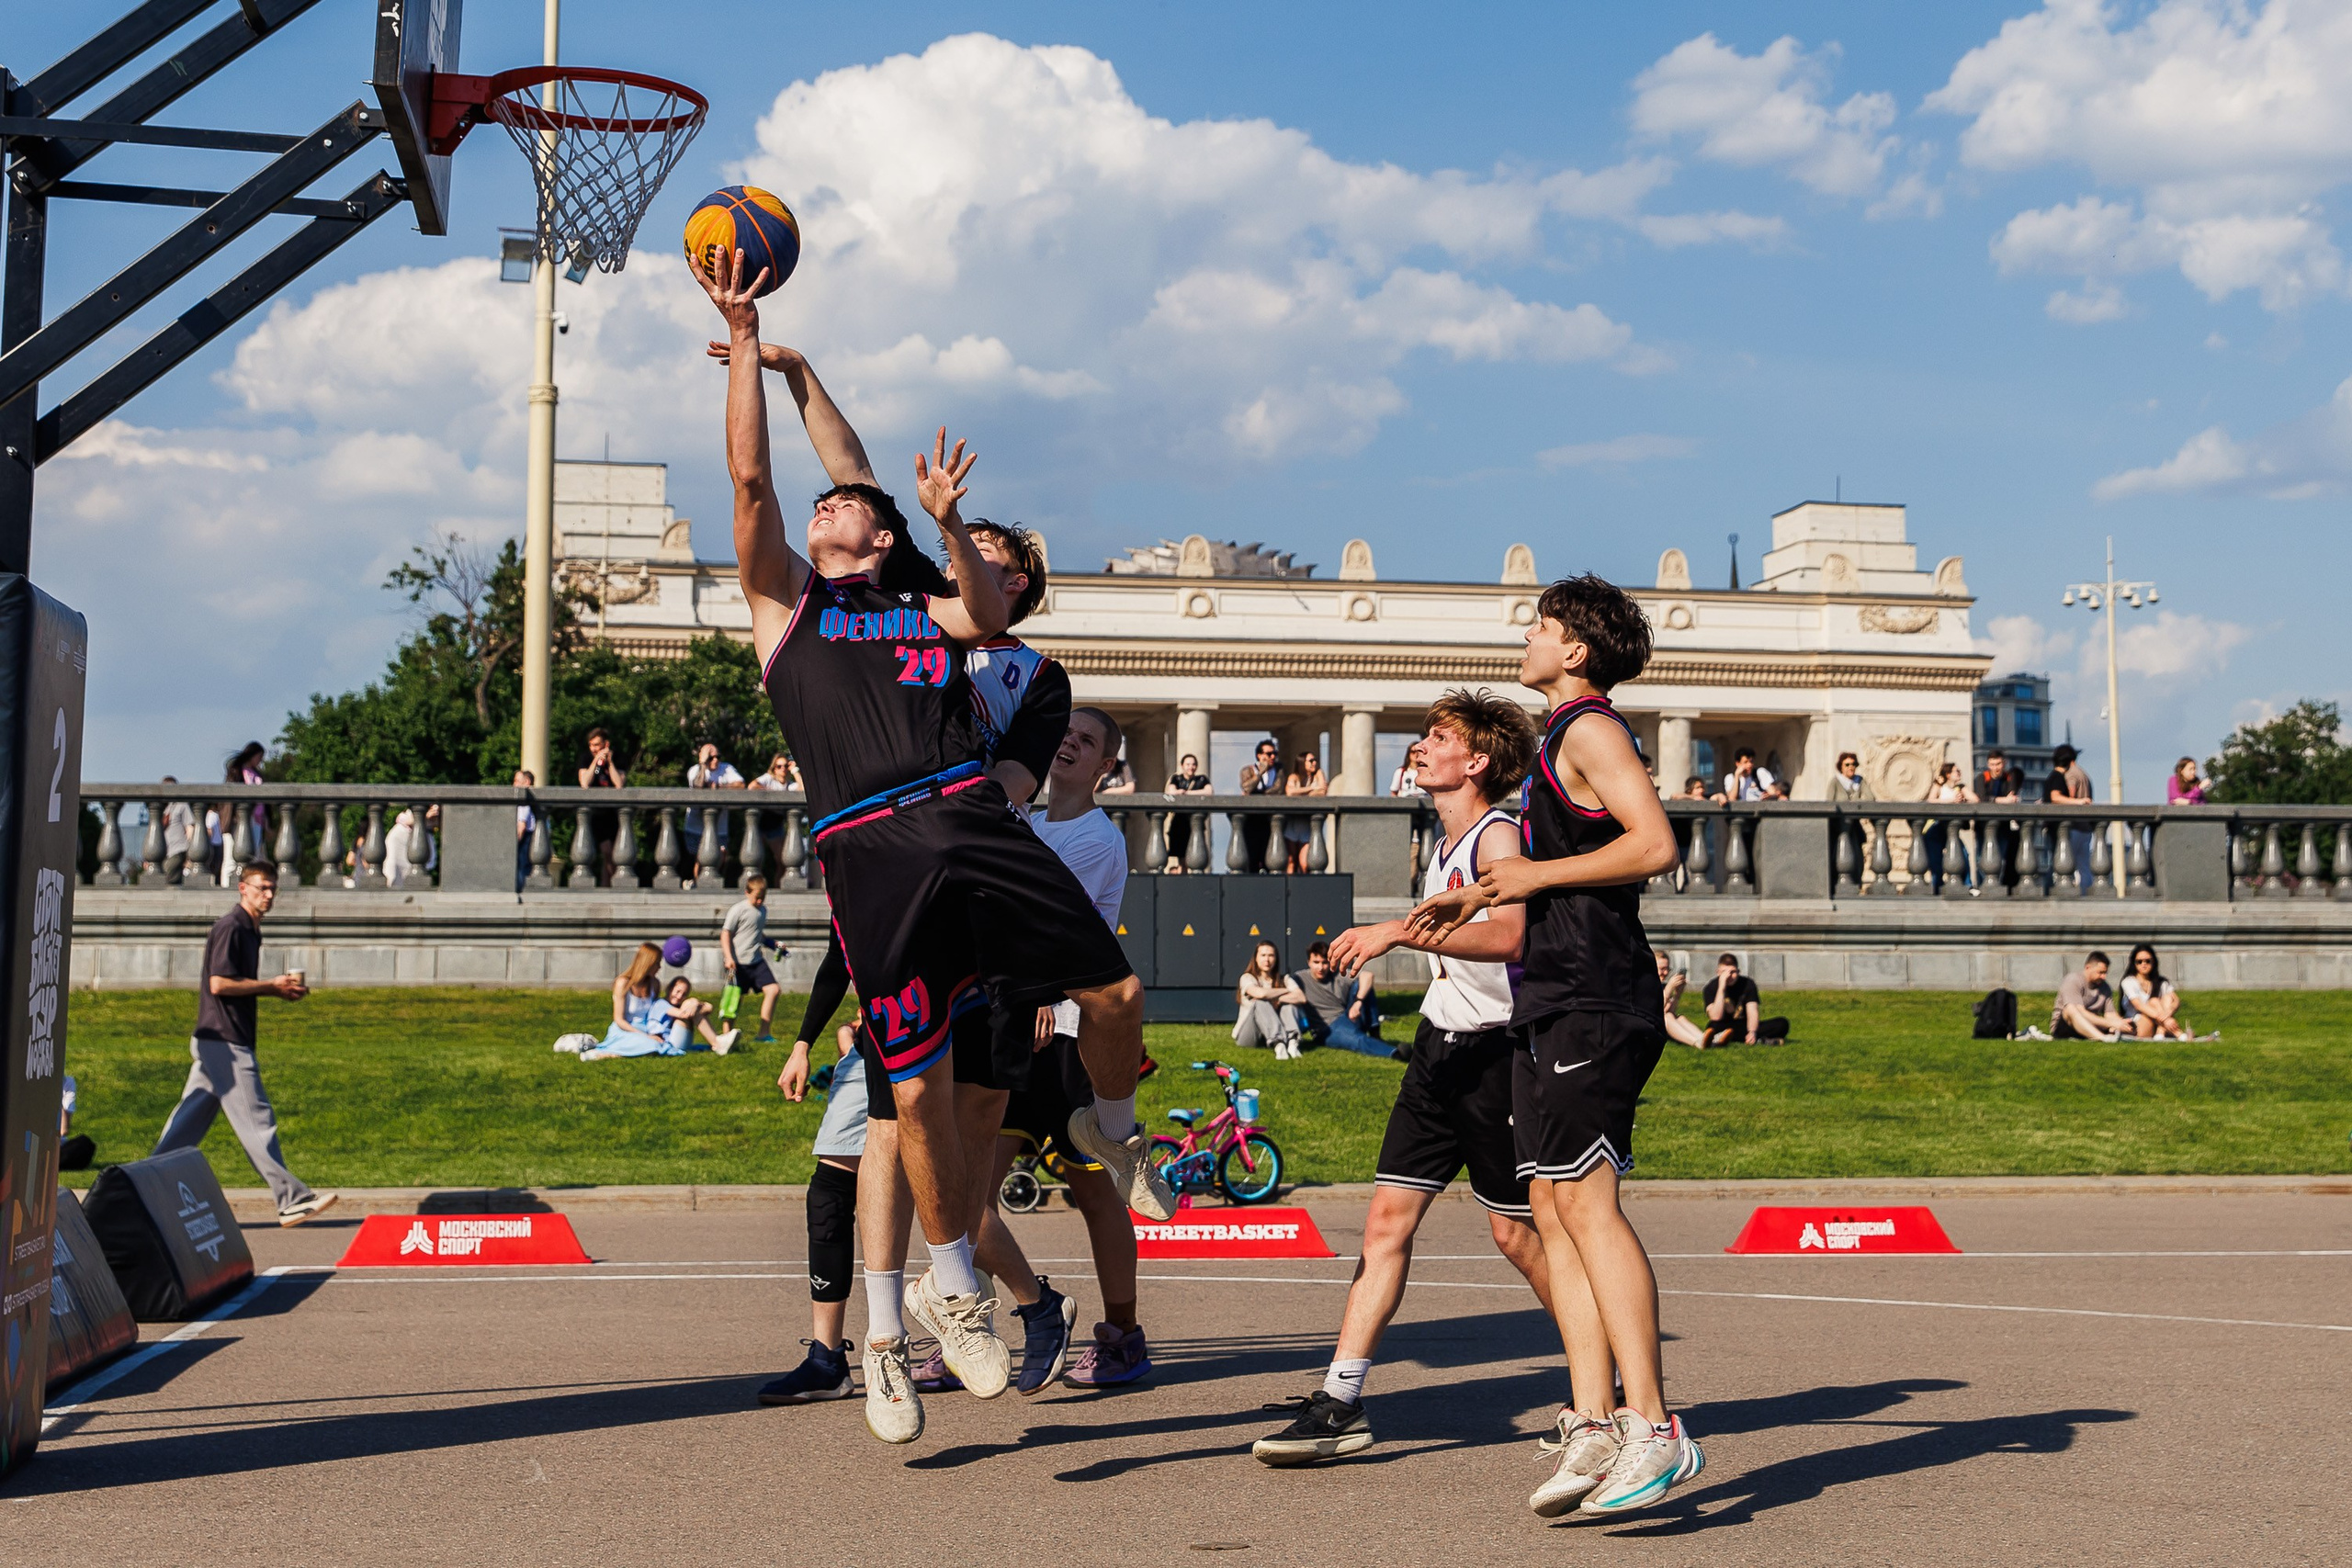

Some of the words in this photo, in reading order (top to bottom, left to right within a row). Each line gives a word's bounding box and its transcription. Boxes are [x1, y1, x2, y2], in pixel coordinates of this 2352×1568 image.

[819, 606, 941, 642] ФЕНИКС
[48, 706, 67, 823] 2
[34, 867, 64, 934] СТРИТ
[29, 933, 62, 997] БАСКЕТ
[28, 985, 58, 1042] ТУР
[26, 1034, 54, 1081] МОСКВА
[438, 1217, 532, 1238] МОСКОВСКИЙ
[1134, 1224, 1300, 1241] STREETBASKET
[1825, 1219, 1895, 1235] МОСКОВСКИЙ
[1826, 1235, 1860, 1249] СПОРТ
[437, 1237, 483, 1256] СПОРТ
